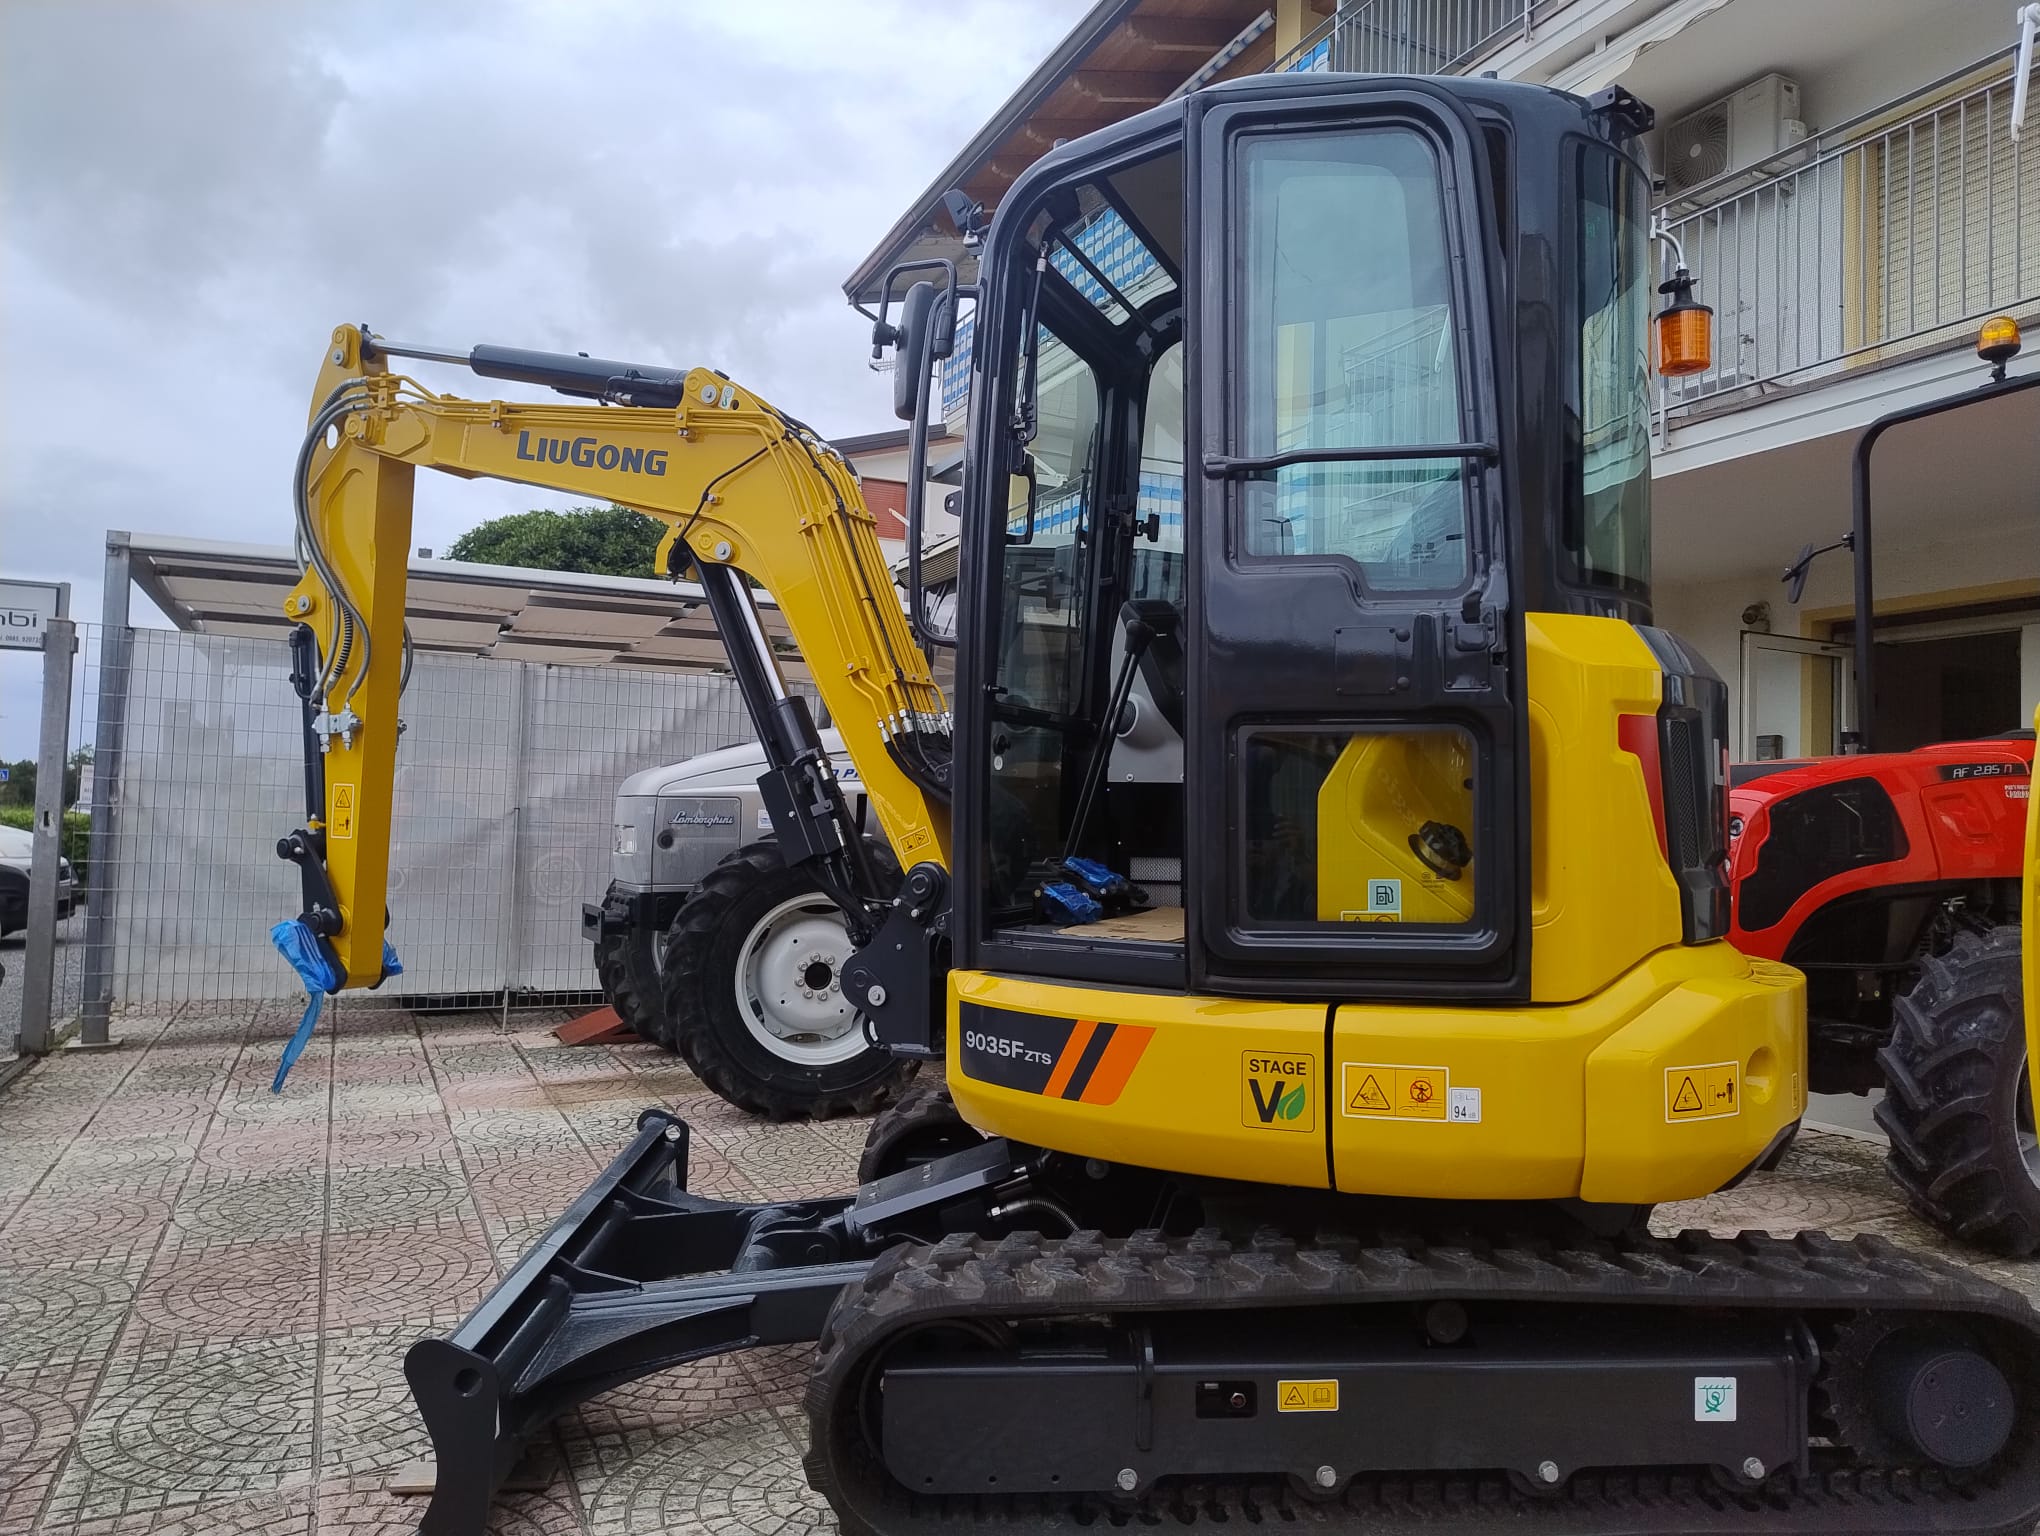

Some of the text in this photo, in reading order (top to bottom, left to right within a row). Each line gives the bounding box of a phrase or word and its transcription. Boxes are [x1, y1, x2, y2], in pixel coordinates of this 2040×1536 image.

[1953, 767, 1970, 779] AF
[1973, 765, 2000, 776] 2.85
[668, 810, 734, 828] Lamborghini
[1249, 1058, 1307, 1076] STAGE
[1247, 1078, 1286, 1123] V
[1454, 1105, 1467, 1119] 94
